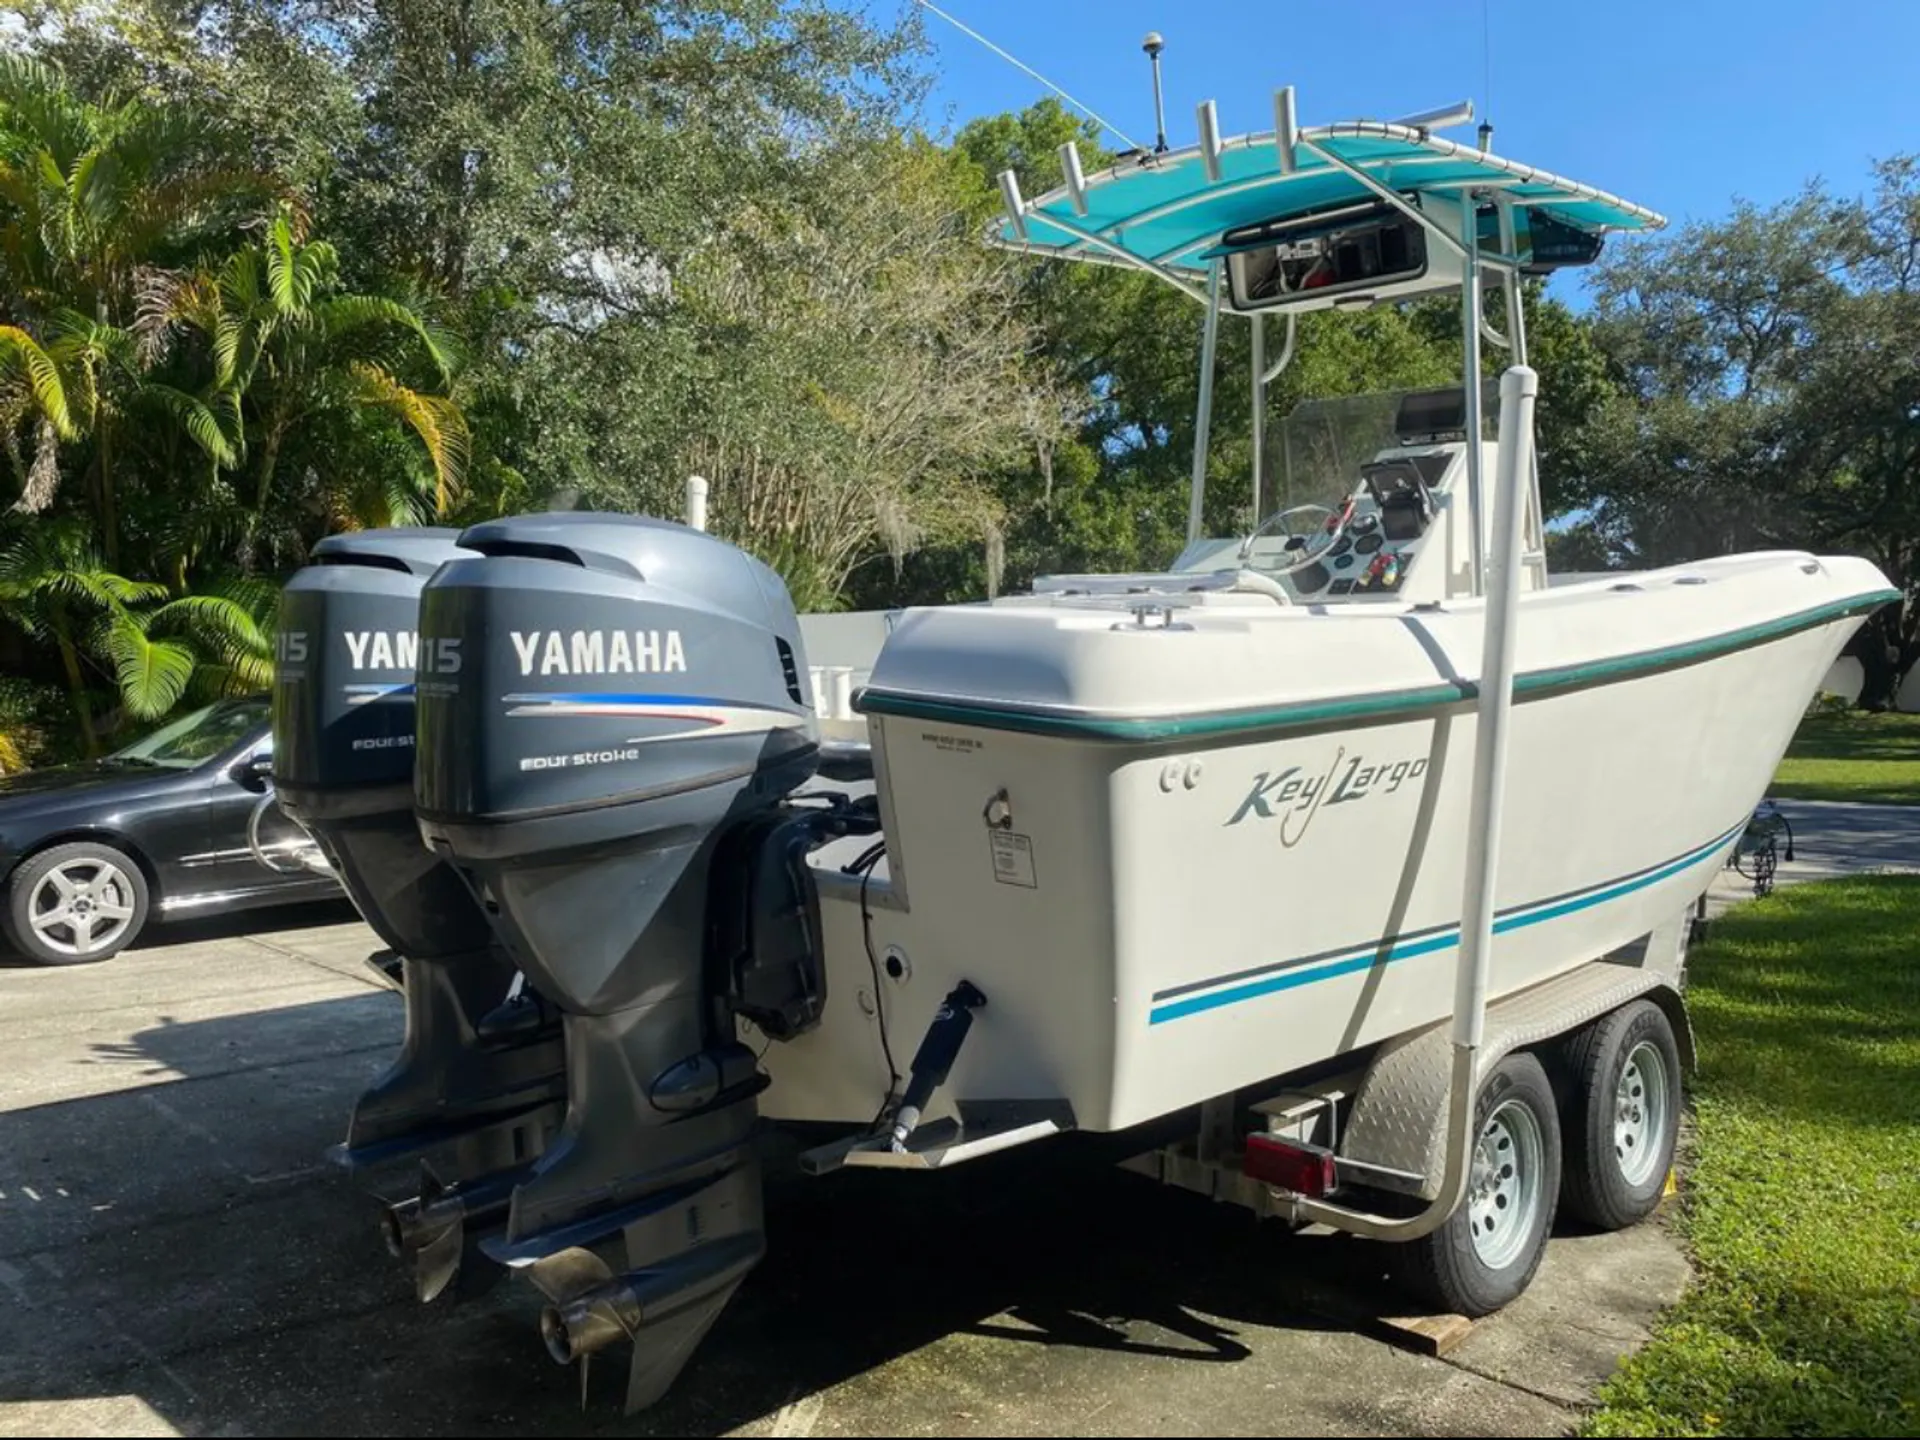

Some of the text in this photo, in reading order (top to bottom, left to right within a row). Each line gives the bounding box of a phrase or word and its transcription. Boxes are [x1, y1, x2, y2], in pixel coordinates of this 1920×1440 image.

[344, 631, 418, 670] YAM
[509, 629, 688, 677] YAMAHA
[1222, 755, 1428, 827] Key Largo
